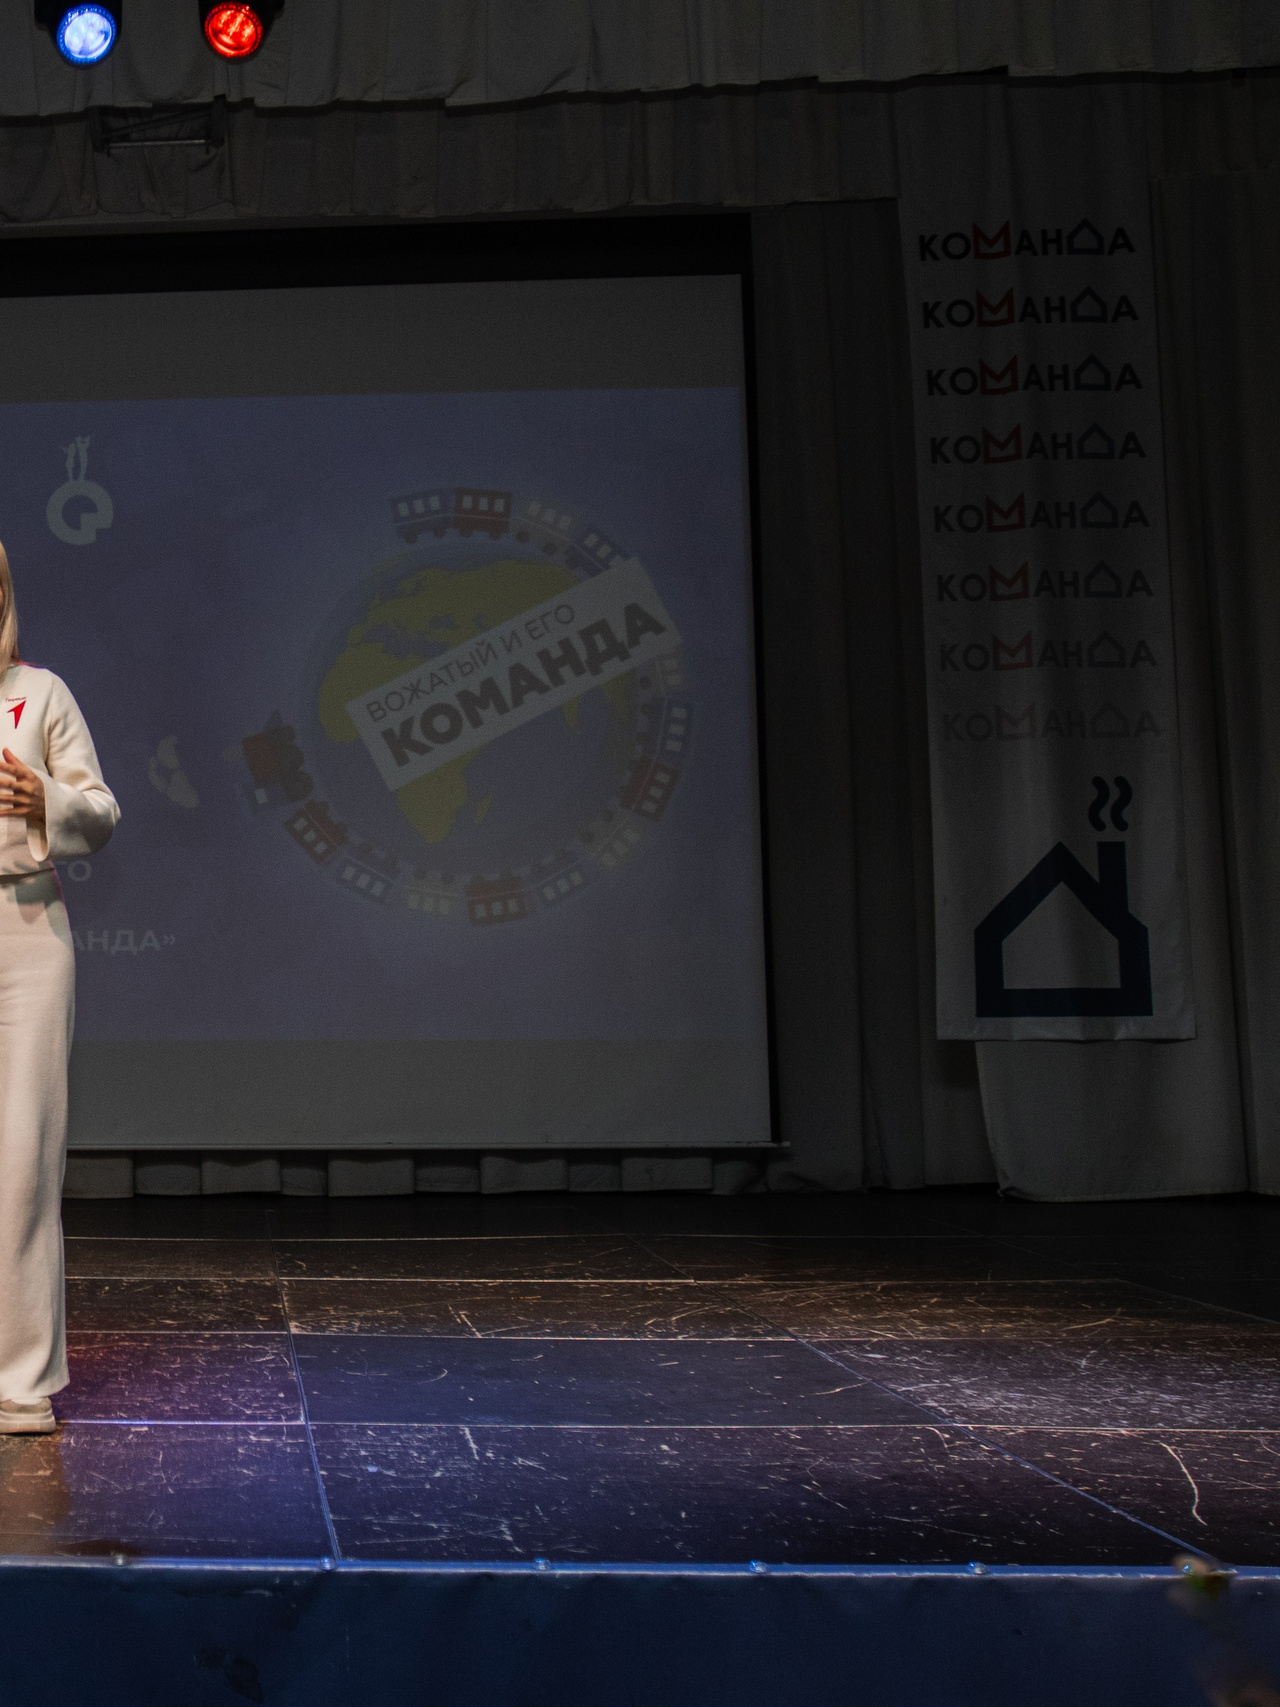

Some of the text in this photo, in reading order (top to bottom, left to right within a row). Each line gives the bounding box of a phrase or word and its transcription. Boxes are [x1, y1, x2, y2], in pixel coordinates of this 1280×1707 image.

[367, 604, 575, 723] ВОЖАТЫЙ И ЕГО
[380, 602, 667, 767] КОМАНДА
